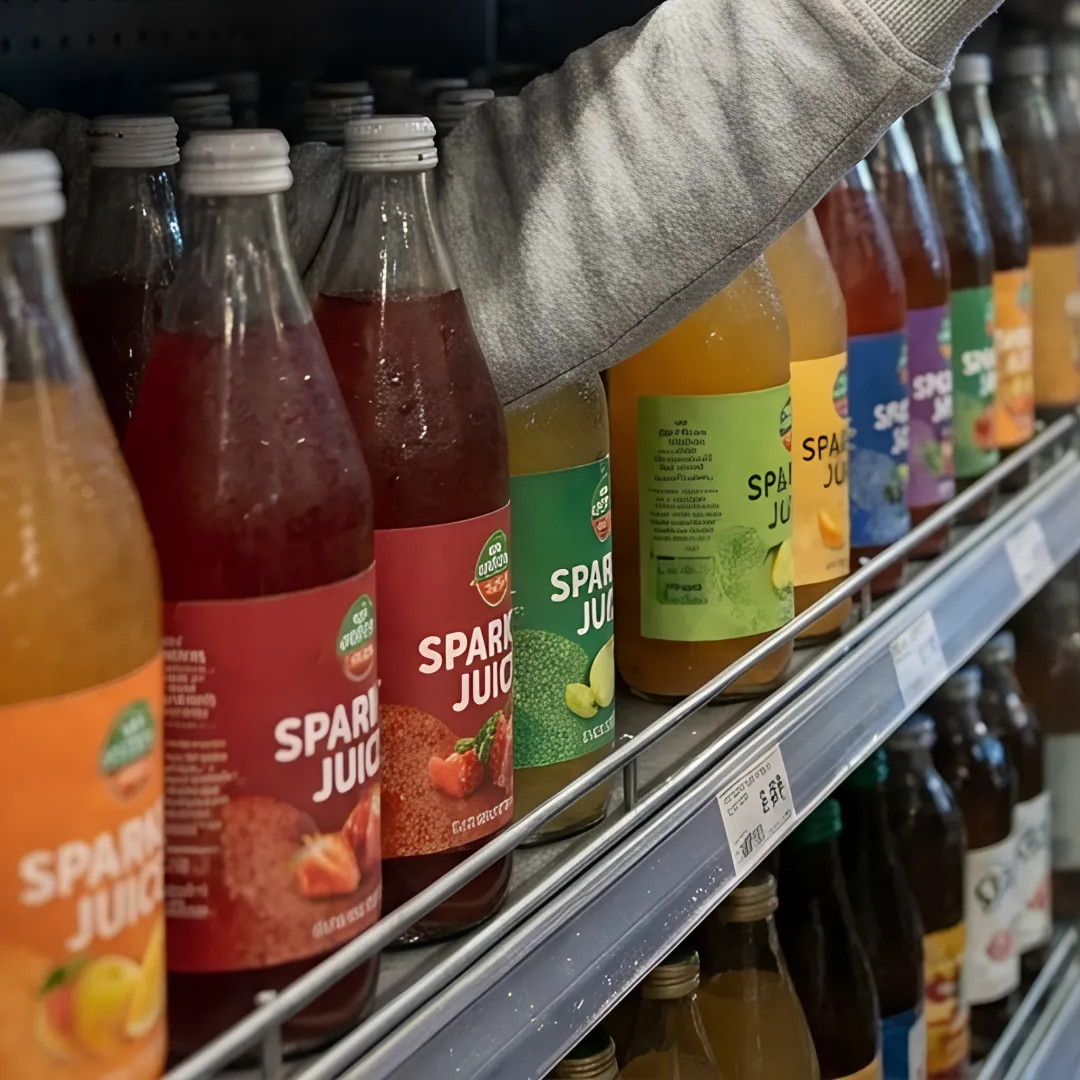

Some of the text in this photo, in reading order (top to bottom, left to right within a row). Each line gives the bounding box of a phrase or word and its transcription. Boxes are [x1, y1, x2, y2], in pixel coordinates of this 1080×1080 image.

[550, 551, 613, 602] SPAR
[452, 651, 513, 712] JUIC
[312, 727, 380, 803] JUIC
[64, 862, 163, 952] JUIC
